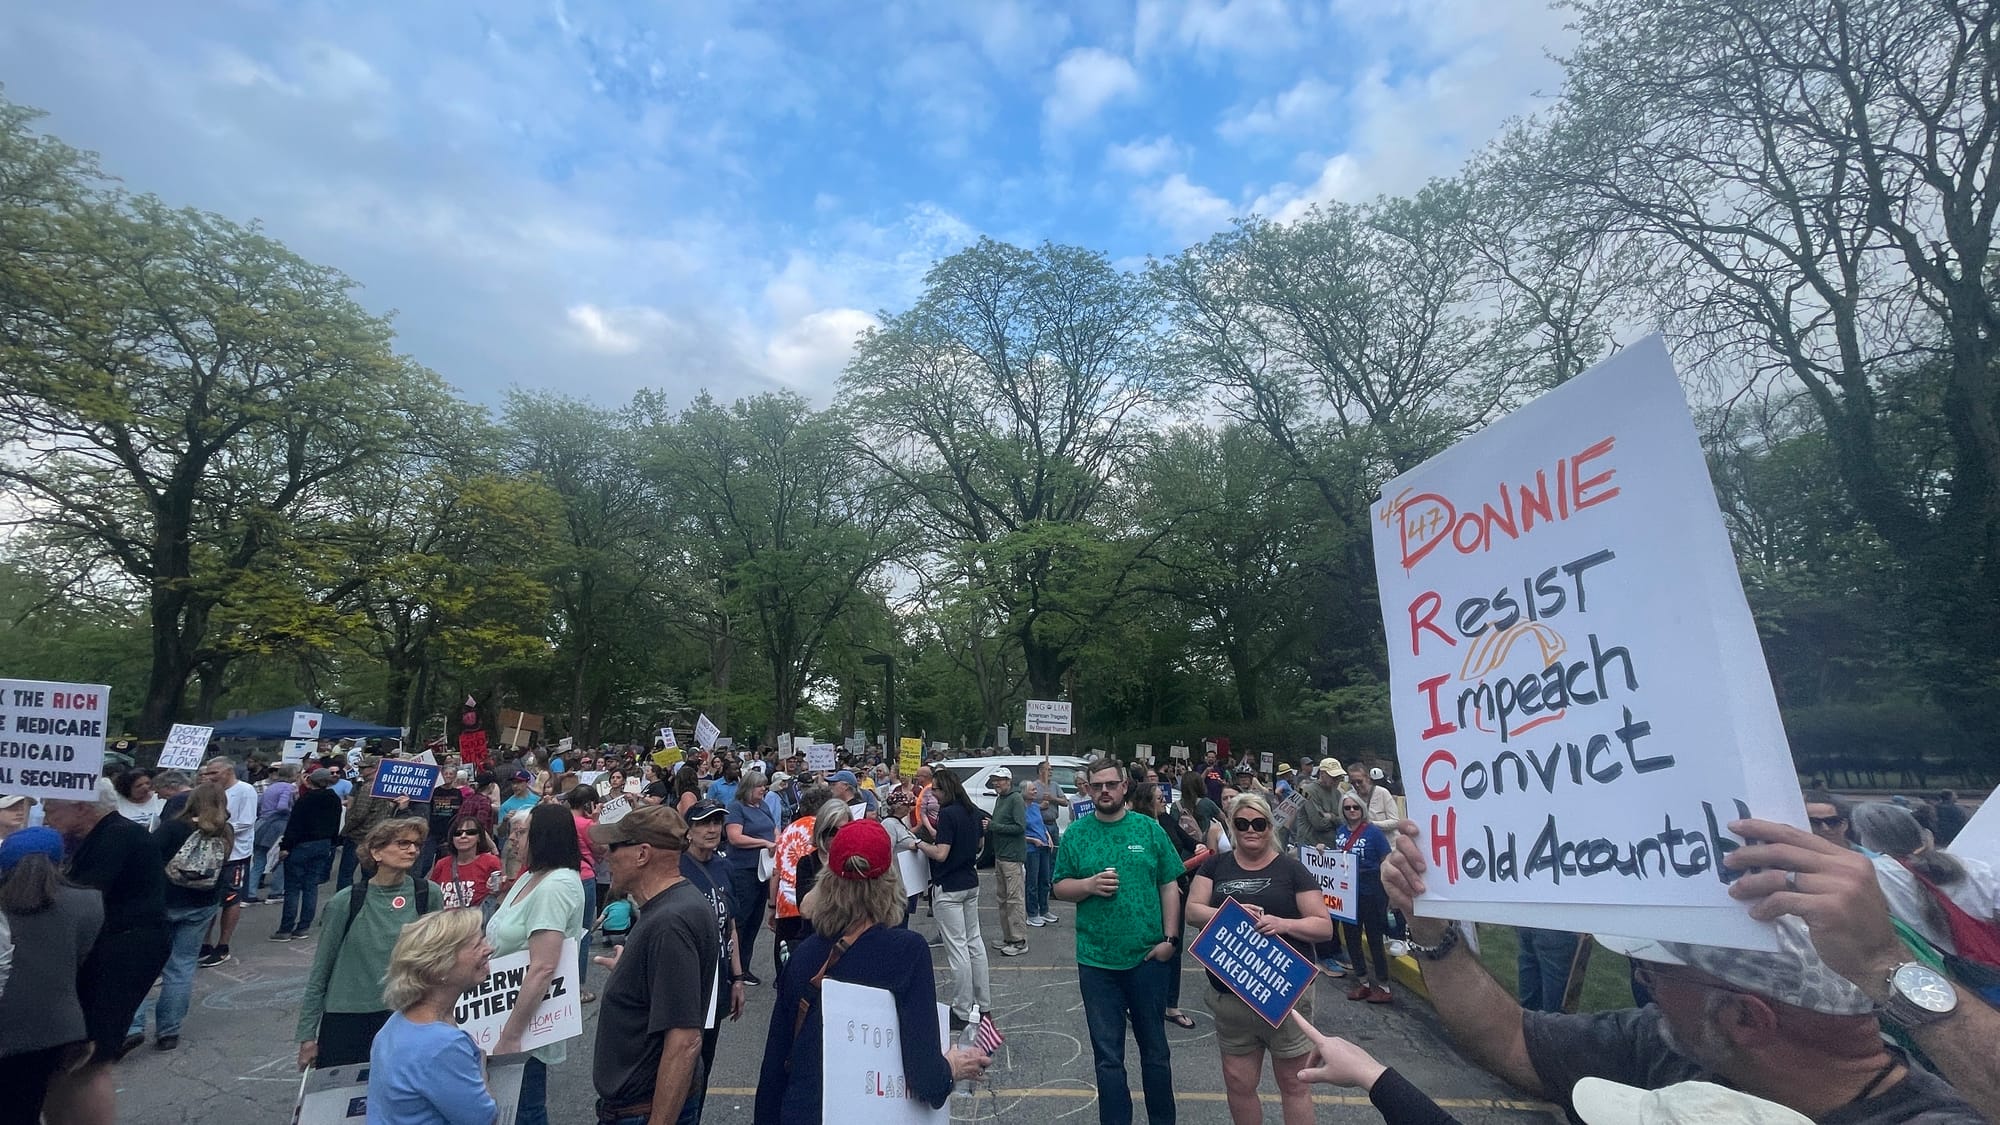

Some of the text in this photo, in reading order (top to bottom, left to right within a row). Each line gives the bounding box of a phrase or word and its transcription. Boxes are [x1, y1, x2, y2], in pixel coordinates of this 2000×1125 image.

[1395, 437, 1621, 569] DONNIE
[1408, 507, 1444, 541] 47
[1418, 634, 1640, 742] Impeach
[14, 690, 44, 707] THE
[53, 692, 98, 710] RICH
[16, 716, 102, 737] MEDICARE
[174, 725, 210, 736] DON'T
[168, 733, 208, 746] CROWN
[0, 741, 75, 762] EDICAID
[160, 754, 200, 767] CLOWN
[172, 746, 199, 757] THE
[20, 769, 98, 790] SECURITY
[381, 774, 432, 787] BILLIONAIRE
[392, 765, 429, 777] STOP THE
[382, 783, 423, 796] TAKEOVER
[1431, 807, 1517, 884] Hold
[1306, 853, 1336, 870] TRUMP
[1236, 920, 1293, 973] STOP THE
[1215, 926, 1293, 997] BILLIONAIRE
[1210, 944, 1272, 1005] TAKEOVER
[847, 1020, 894, 1048] STOP
